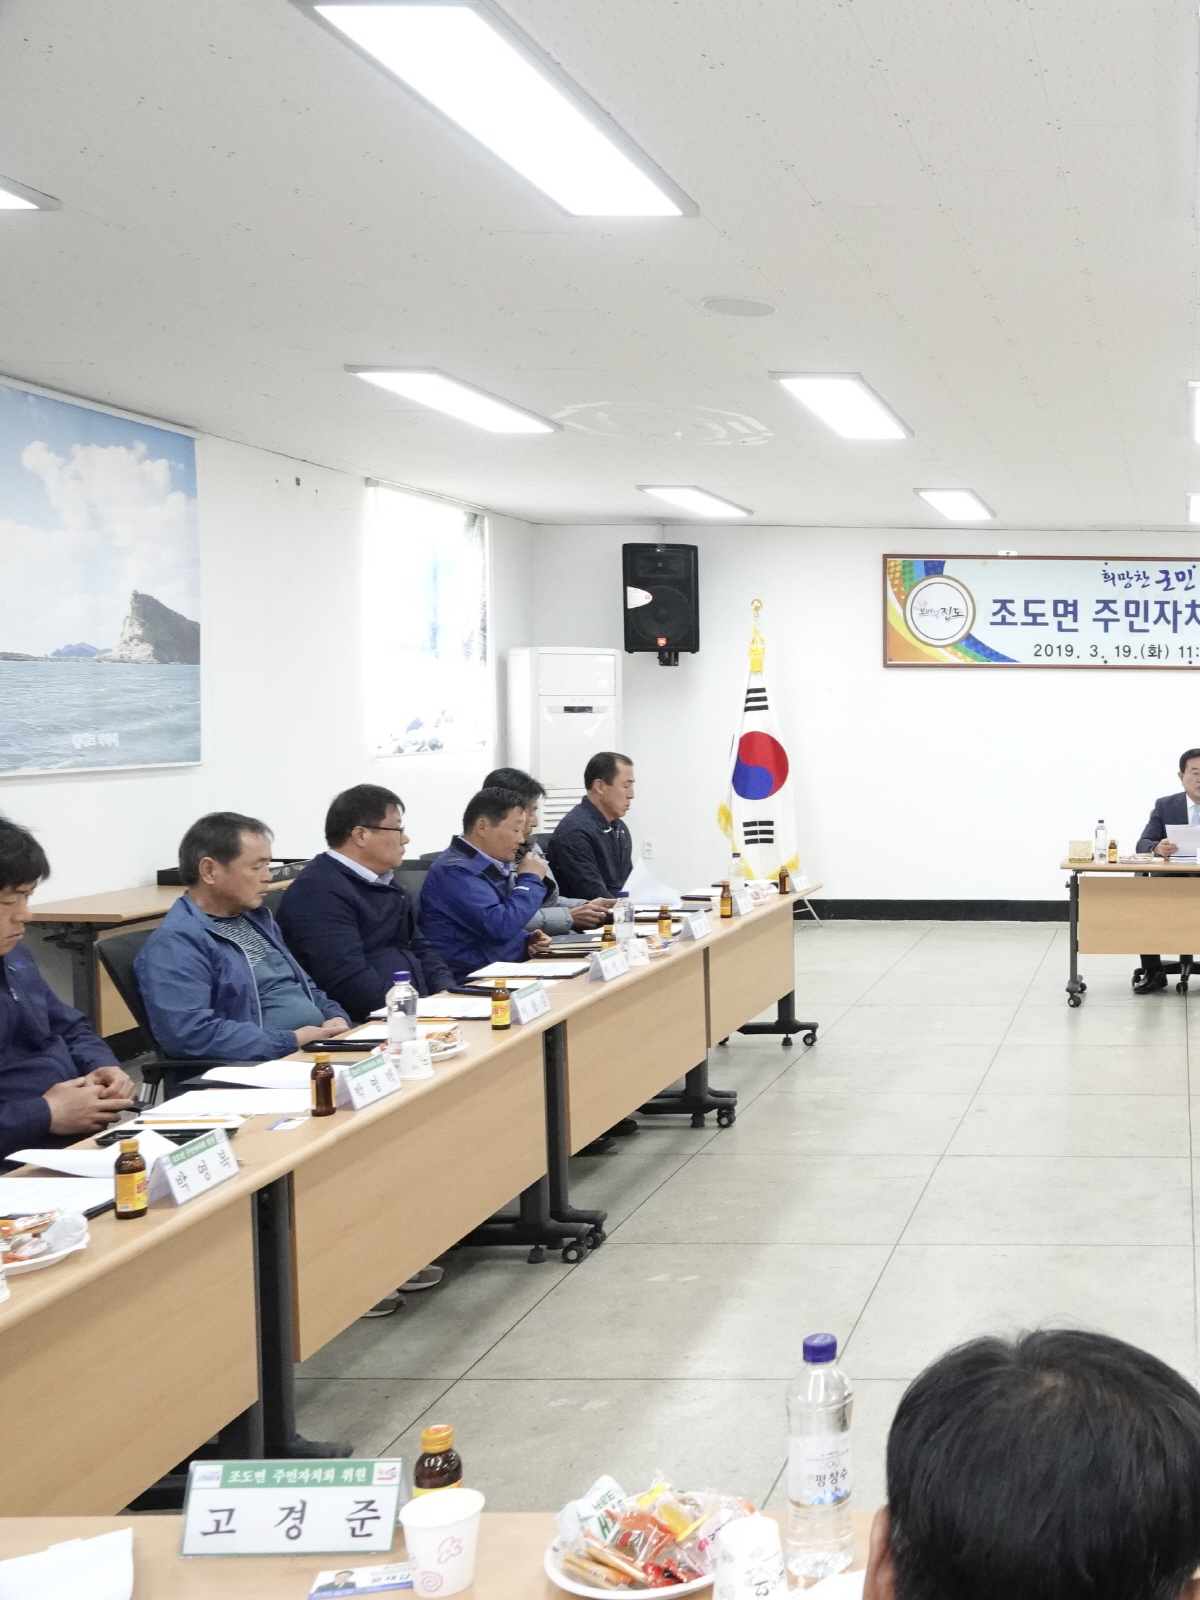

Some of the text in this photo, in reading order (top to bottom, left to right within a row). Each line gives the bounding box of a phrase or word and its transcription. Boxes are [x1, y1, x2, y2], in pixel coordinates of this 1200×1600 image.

[1101, 569, 1150, 589] 희망찬
[1155, 568, 1196, 592] 군민
[989, 598, 1080, 633] 조도면
[1033, 643, 1081, 660] 2019.
[1089, 644, 1105, 660] 3.
[1115, 643, 1170, 660] 19.(화)
[227, 1467, 367, 1484] 조도면 주민자치회 위원
